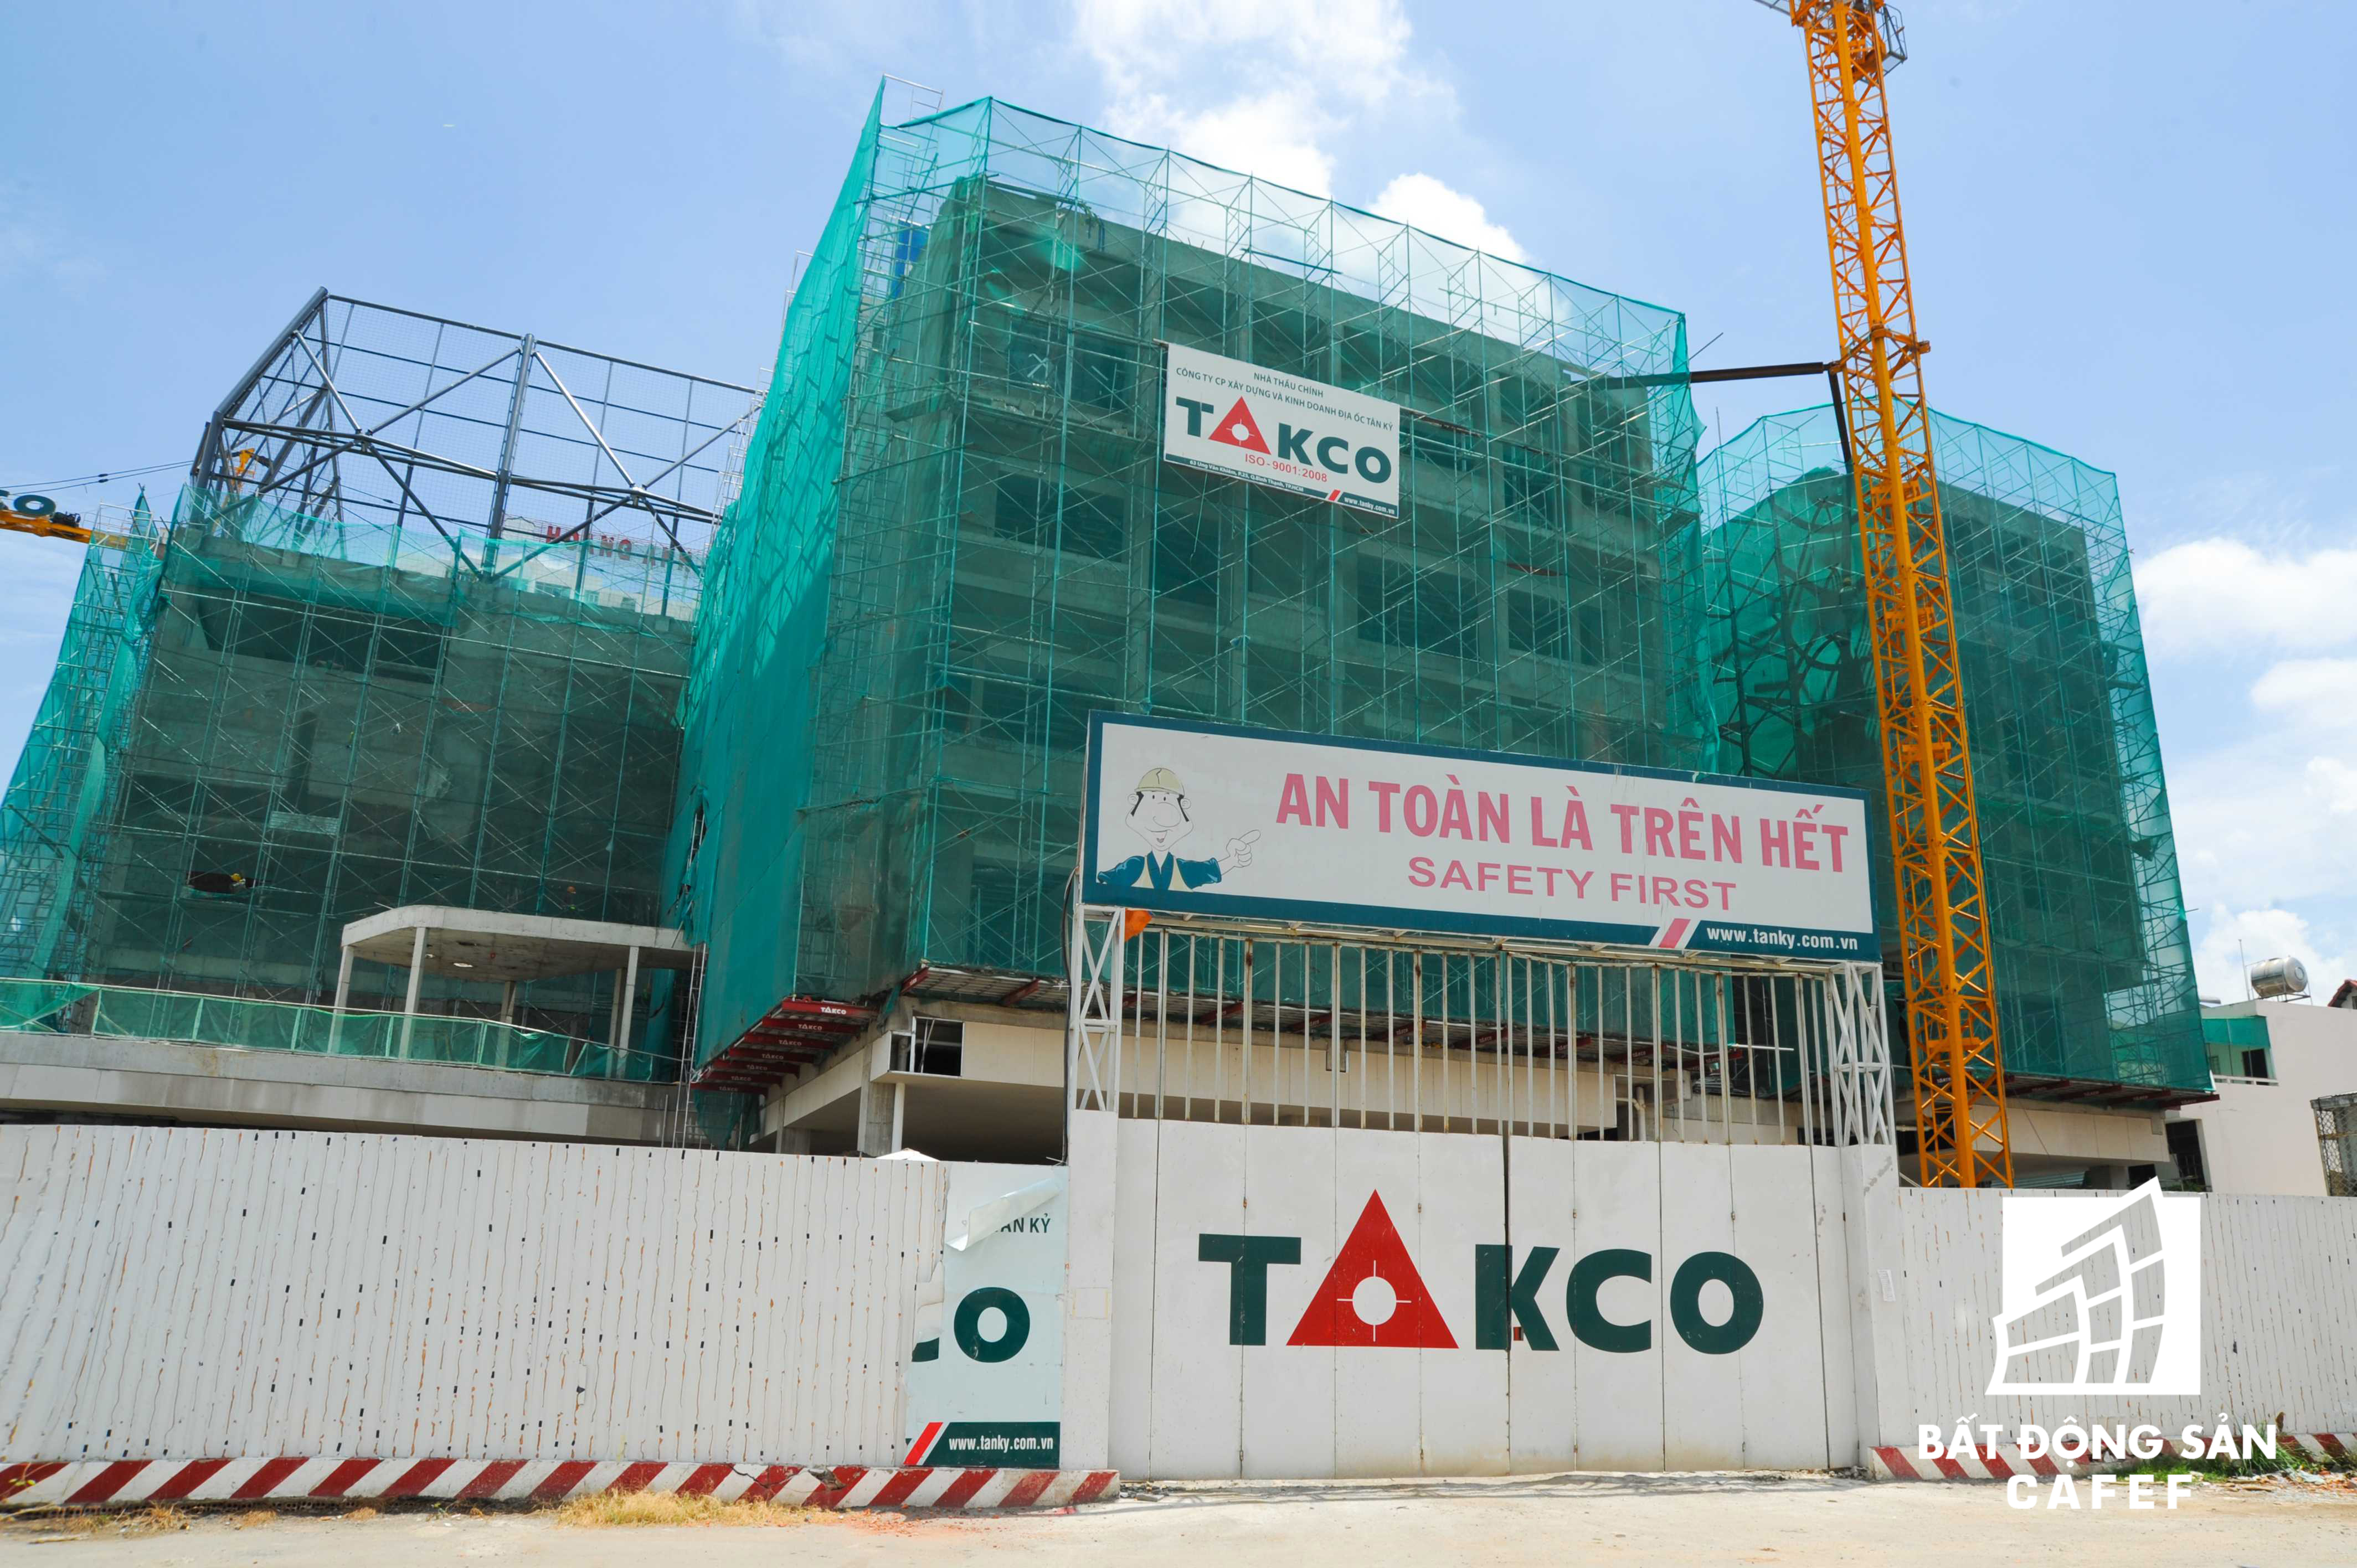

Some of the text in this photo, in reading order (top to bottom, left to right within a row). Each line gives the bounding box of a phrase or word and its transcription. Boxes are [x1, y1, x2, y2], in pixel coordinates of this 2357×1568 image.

[1176, 368, 1201, 380] CÔNG
[1203, 373, 1213, 383] TY
[1215, 377, 1226, 386] CP
[1228, 380, 1244, 391] XÂY
[1246, 384, 1271, 398] DỰNG
[1272, 391, 1283, 402] VÀ
[1285, 395, 1305, 408] KINH
[1307, 401, 1336, 415] DOANH
[1338, 409, 1352, 421] ĐỊA
[1367, 417, 1382, 429] TÂN
[1254, 372, 1272, 384] NHÀ
[1298, 384, 1324, 398] CHÍNH
[1176, 395, 1392, 483] TAKCO
[1245, 453, 1265, 467] ISO
[1272, 461, 1327, 483] 9001:2008
[0, 489, 56, 516] O
[1344, 497, 1395, 515] www.tanky.com.vn
[1276, 773, 1849, 873] AN TOÀN LÀ TRÊN HẾT
[1408, 857, 1737, 911] SAFETY FIRST
[1707, 927, 1859, 951] www.tanky.com.vn
[820, 1006, 847, 1015] TAKCO
[1030, 1213, 1051, 1234] KỶ
[1198, 1189, 1764, 1355] TAKCO
[949, 1435, 1054, 1453] www.tanky.com.vn
